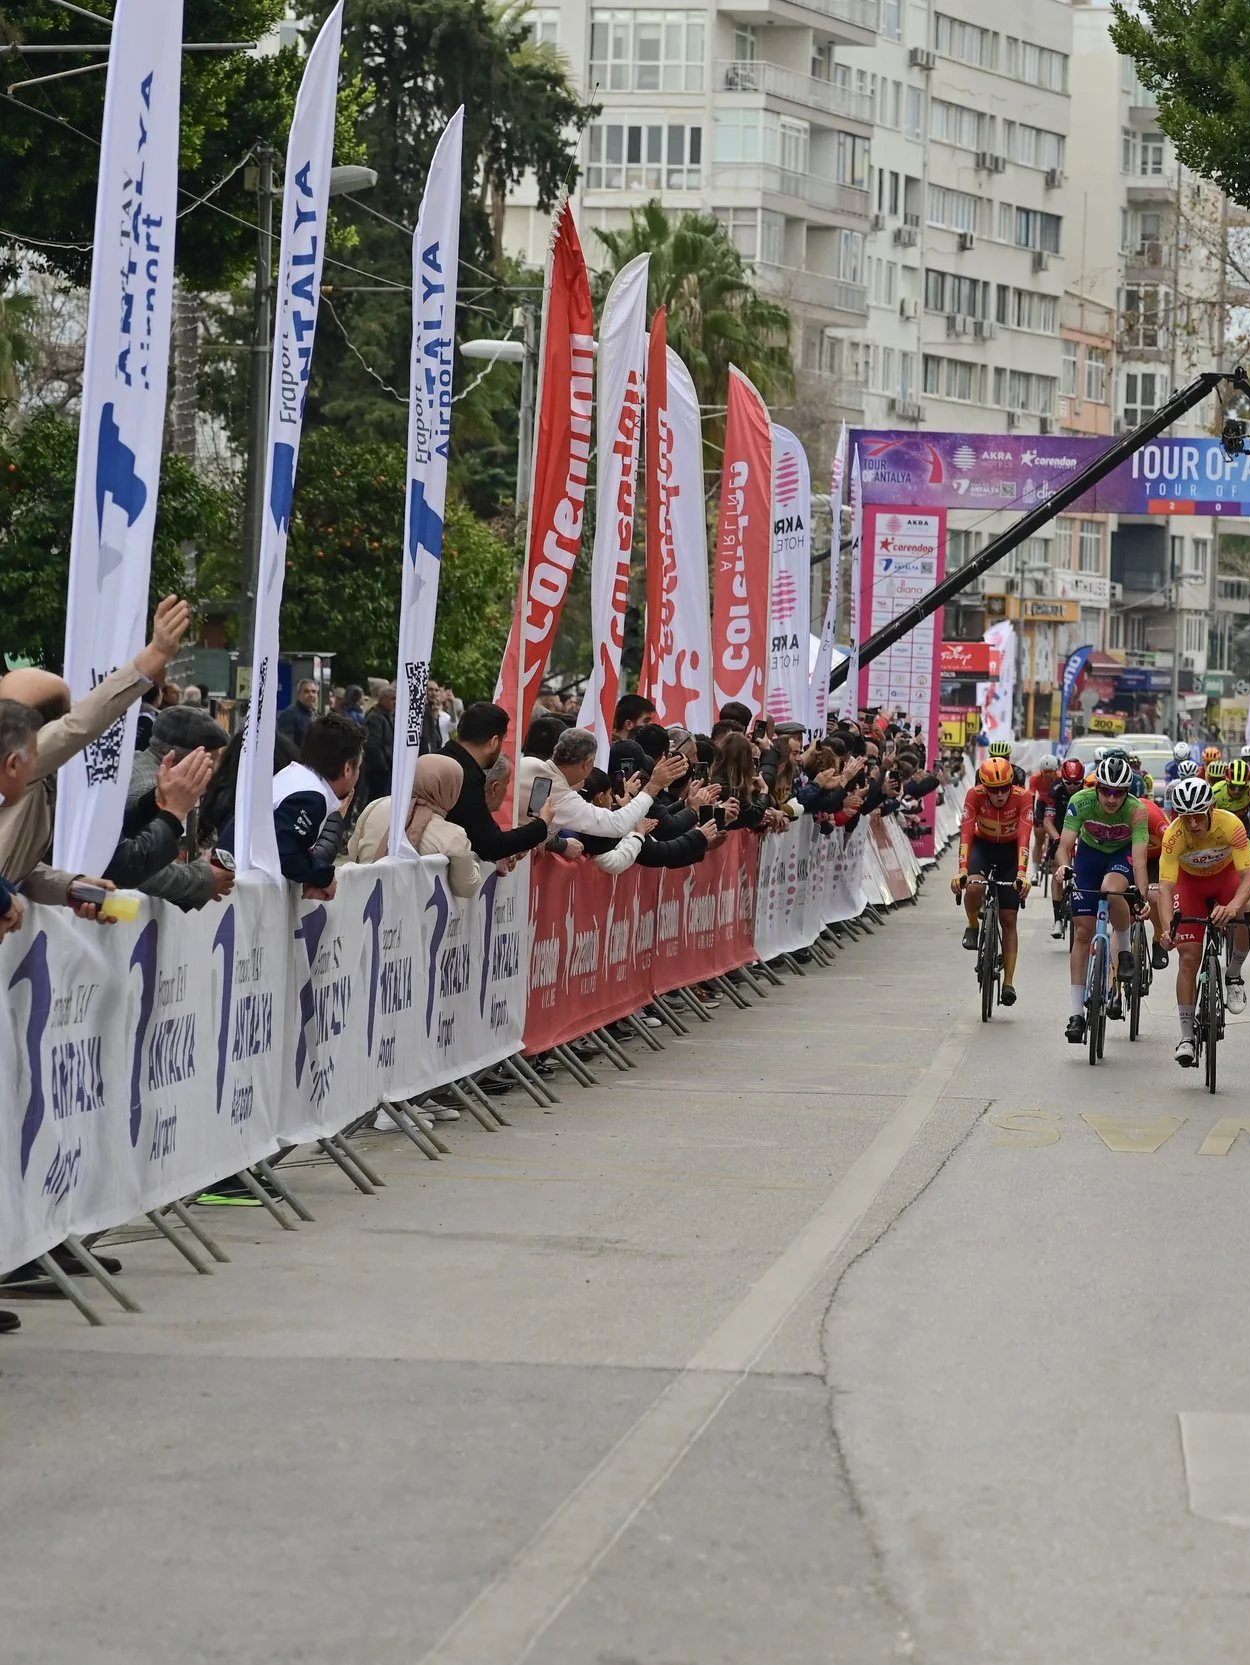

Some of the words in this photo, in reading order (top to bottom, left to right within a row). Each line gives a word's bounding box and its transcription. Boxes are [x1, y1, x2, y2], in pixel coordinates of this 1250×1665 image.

[291, 160, 318, 420] NTALYA
[434, 337, 452, 460] Airport
[863, 458, 887, 471] TOUR
[981, 451, 1013, 461] AKRA
[1034, 455, 1078, 468] corendon
[1131, 445, 1200, 481] TOUR
[1145, 482, 1198, 497] TOUR
[1216, 485, 1238, 498] OF
[1169, 501, 1176, 510] 2
[1215, 504, 1222, 512] 0
[907, 519, 929, 527] AKRA
[1093, 720, 1114, 729] 200
[1162, 828, 1183, 855] diana
[440, 942, 471, 999] ANTALYA
[491, 930, 520, 983] ANTALYA
[232, 992, 273, 1062] ANTALYA
[148, 1012, 196, 1091] ANTALYA
[150, 1104, 177, 1170] Airport
